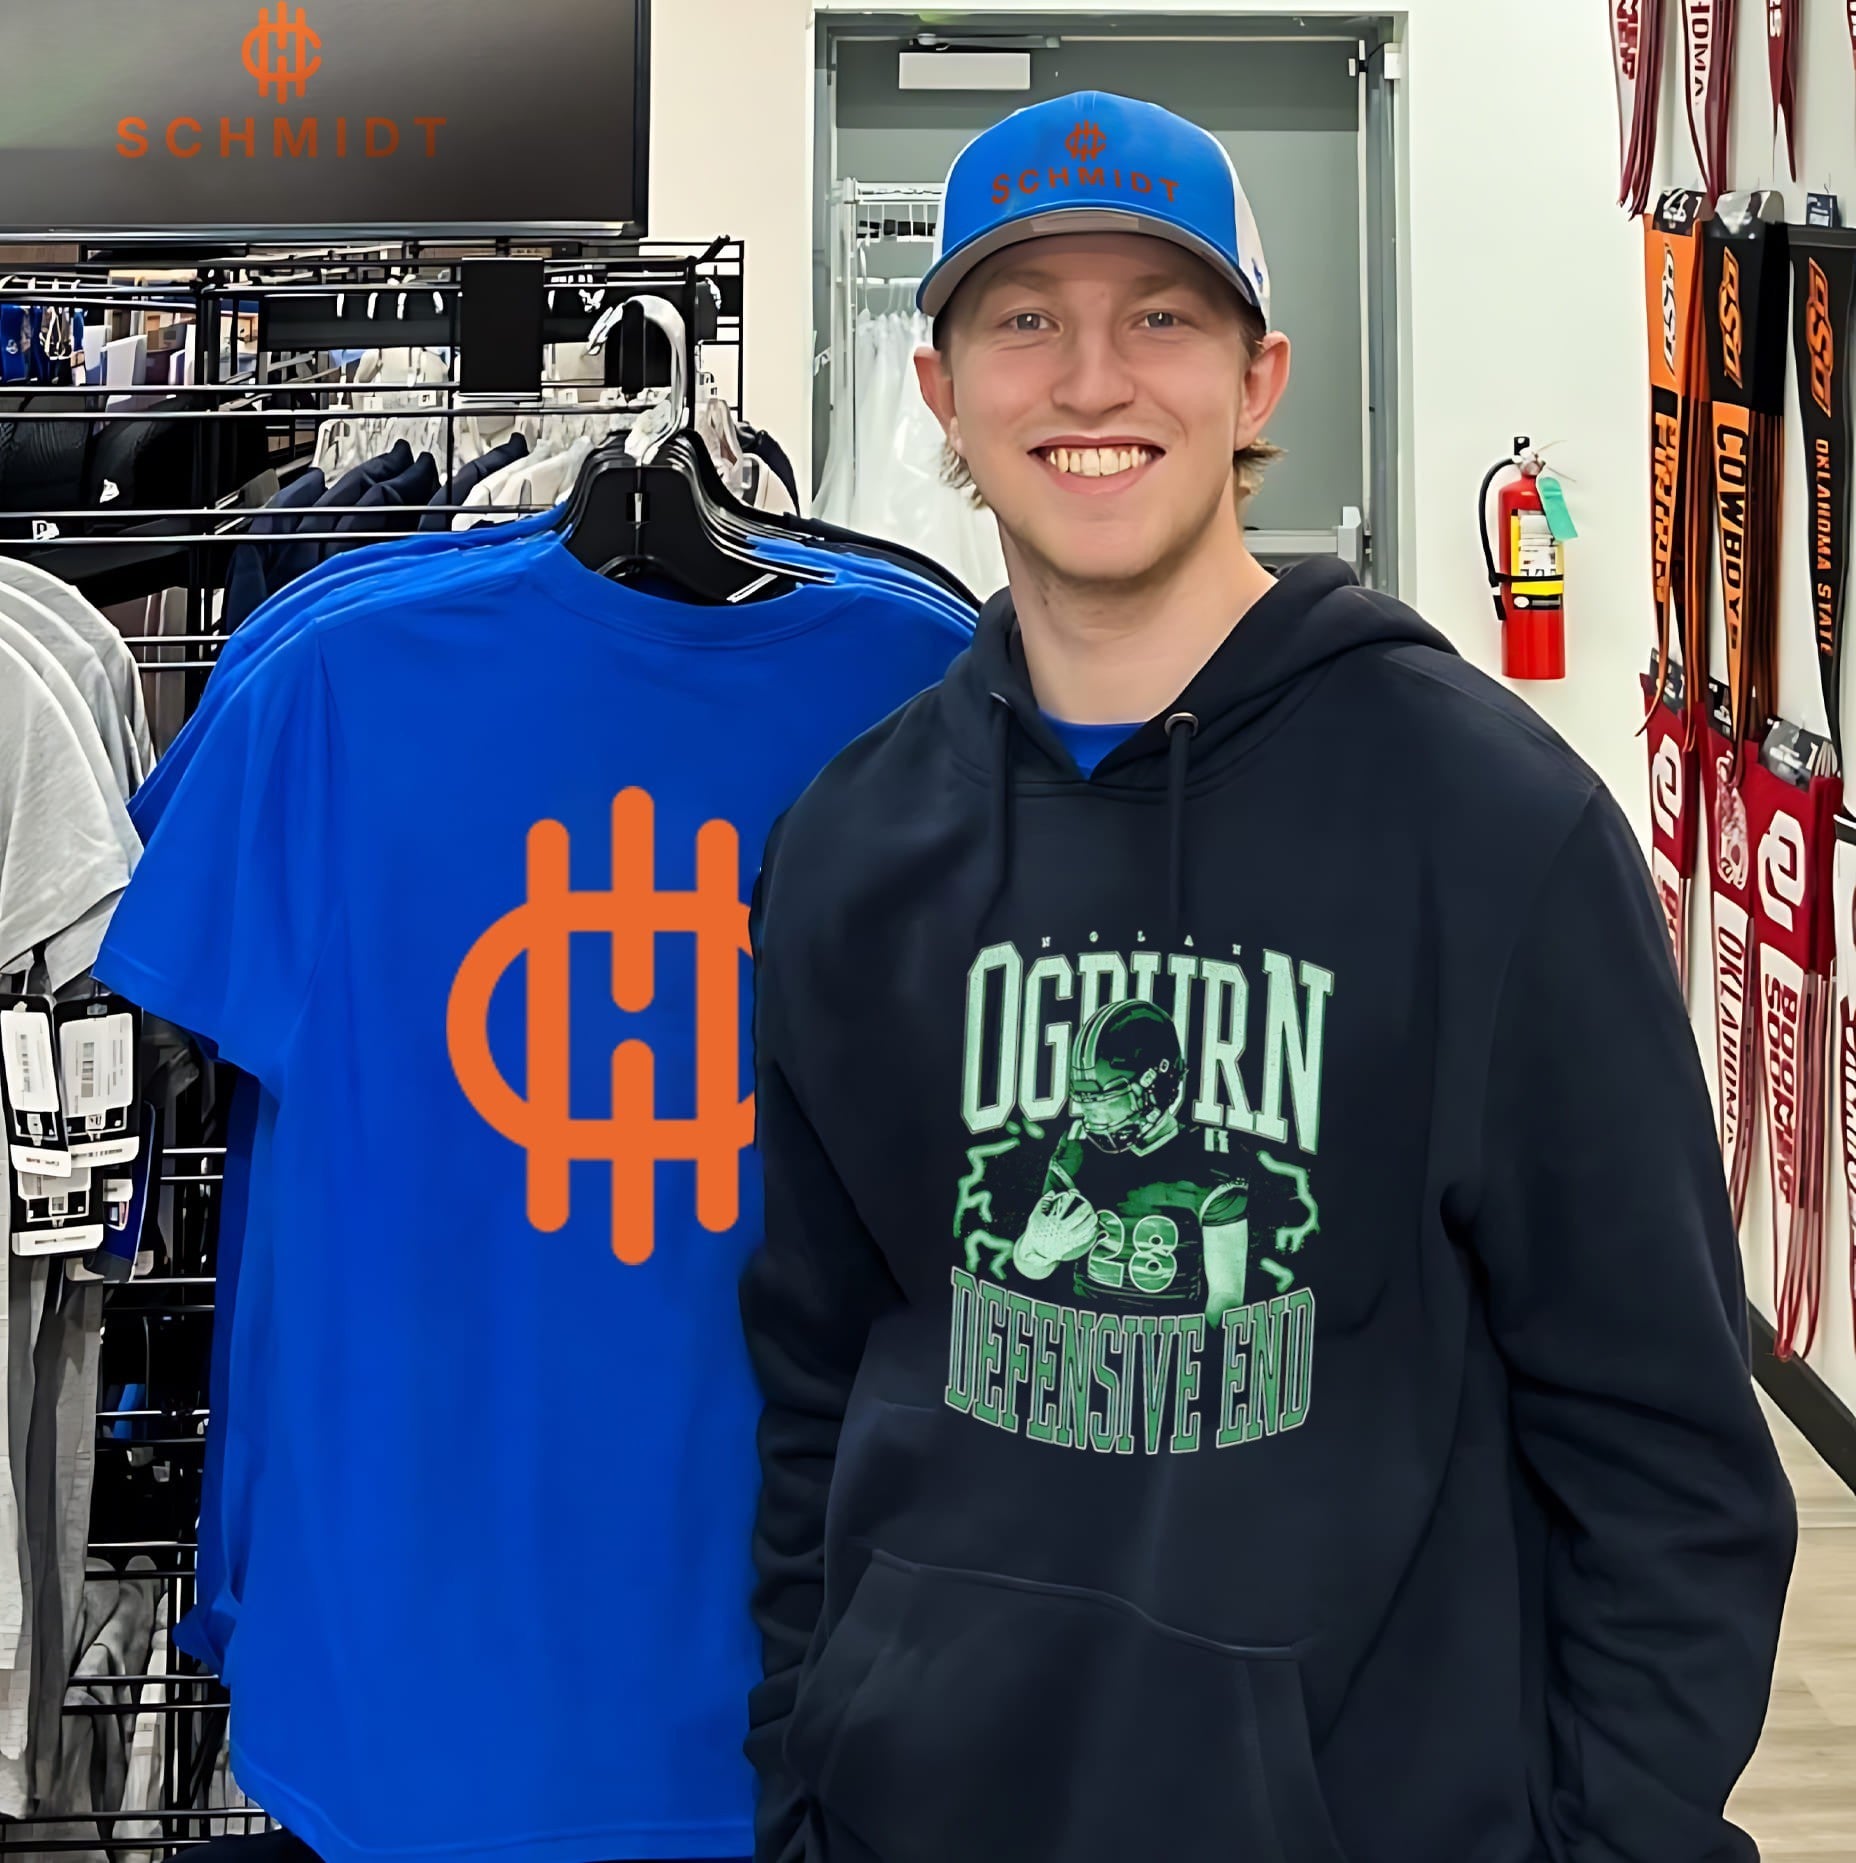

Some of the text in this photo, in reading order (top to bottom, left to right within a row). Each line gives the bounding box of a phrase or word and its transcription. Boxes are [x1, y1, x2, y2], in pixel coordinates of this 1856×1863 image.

[115, 116, 447, 159] SCHMIDT
[991, 167, 1179, 204] SCHMIDT
[1815, 438, 1832, 570] OKLAHOMA
[1041, 930, 1242, 956] NOLAN
[1087, 1208, 1179, 1293] 28
[945, 1266, 1316, 1456] DEFENSIVE END
